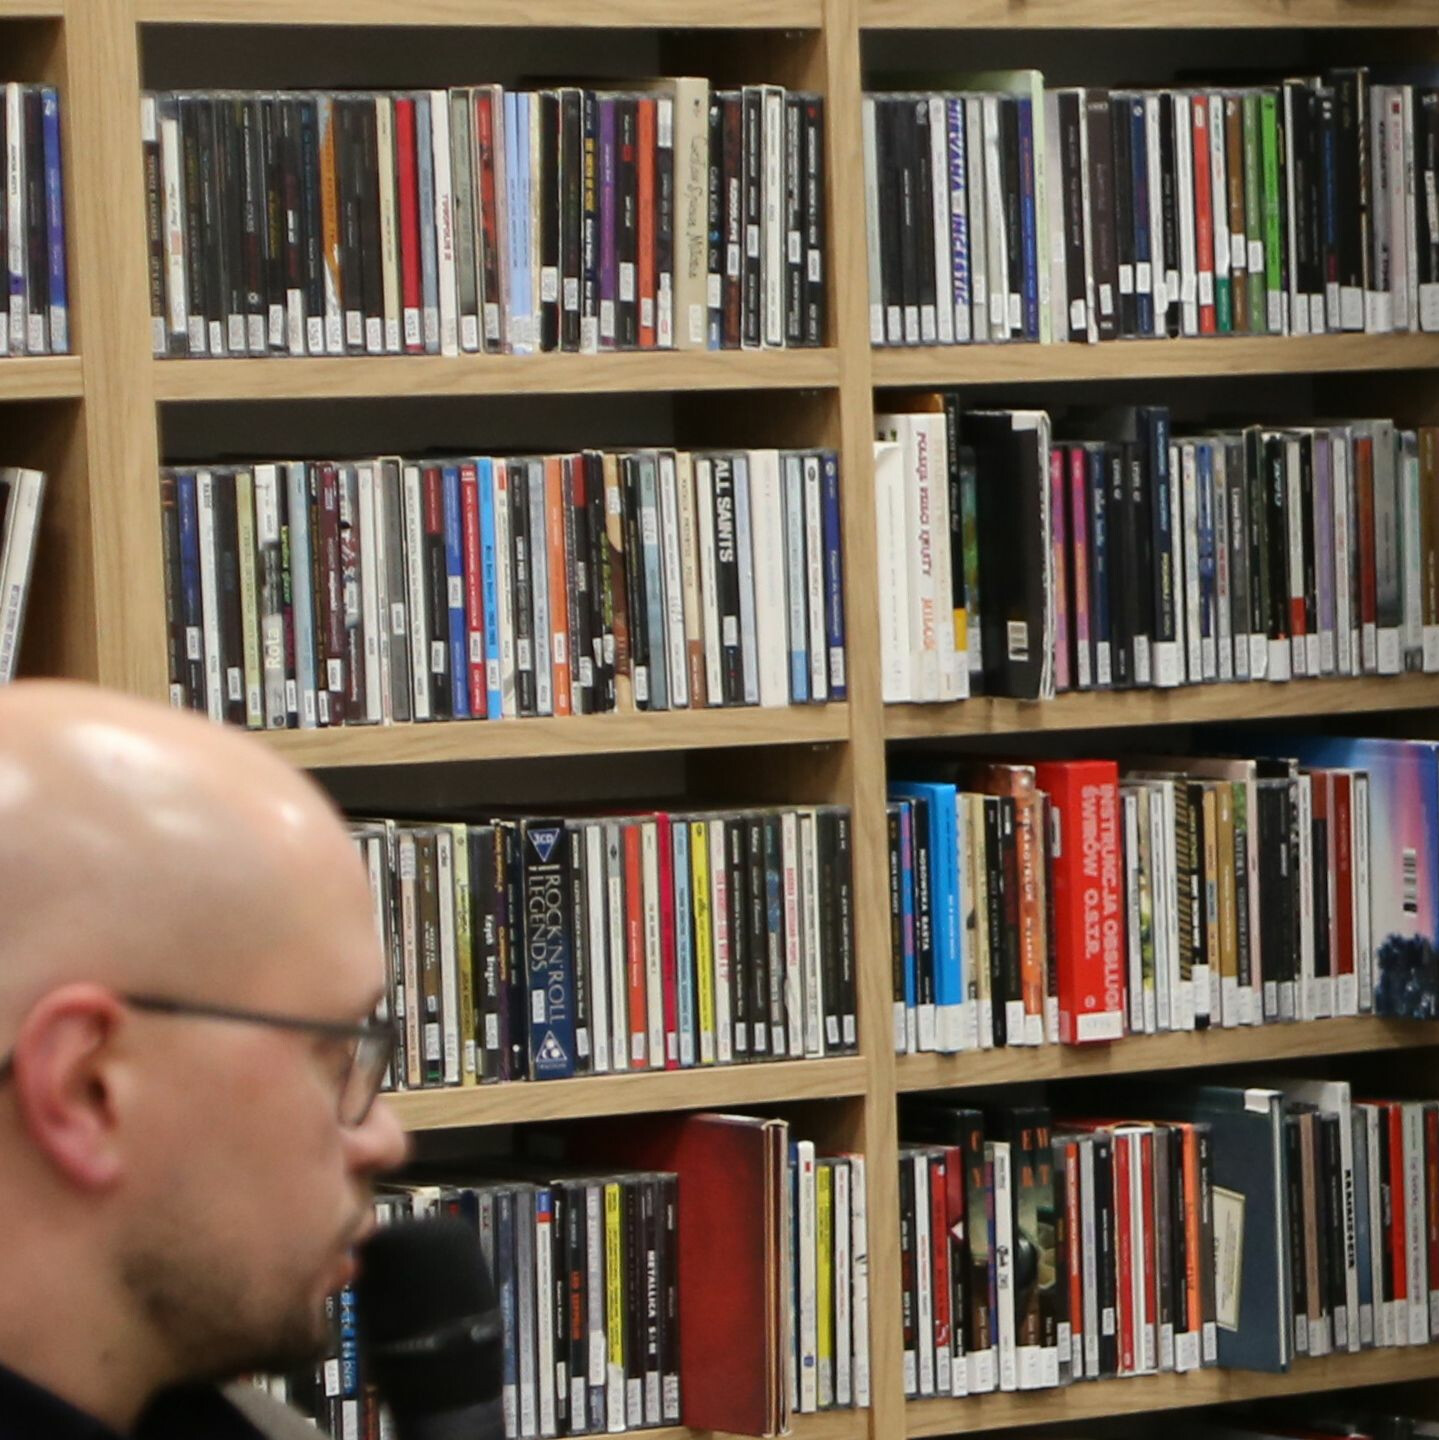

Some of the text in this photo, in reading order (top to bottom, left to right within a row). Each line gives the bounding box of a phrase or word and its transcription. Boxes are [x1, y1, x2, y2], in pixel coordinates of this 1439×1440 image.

[949, 99, 968, 304] NIRVANA INCESTIC
[715, 459, 733, 562] ALL SAINTS
[266, 628, 281, 669] Rota
[918, 849, 930, 951] NOSOWSKA BASTA
[1081, 785, 1100, 959] ŚWIRÓW O.S.T.R.
[1101, 784, 1117, 914] INSTRUKCJA
[528, 876, 547, 972] LEGENDS
[647, 1250, 656, 1317] METALLICA
